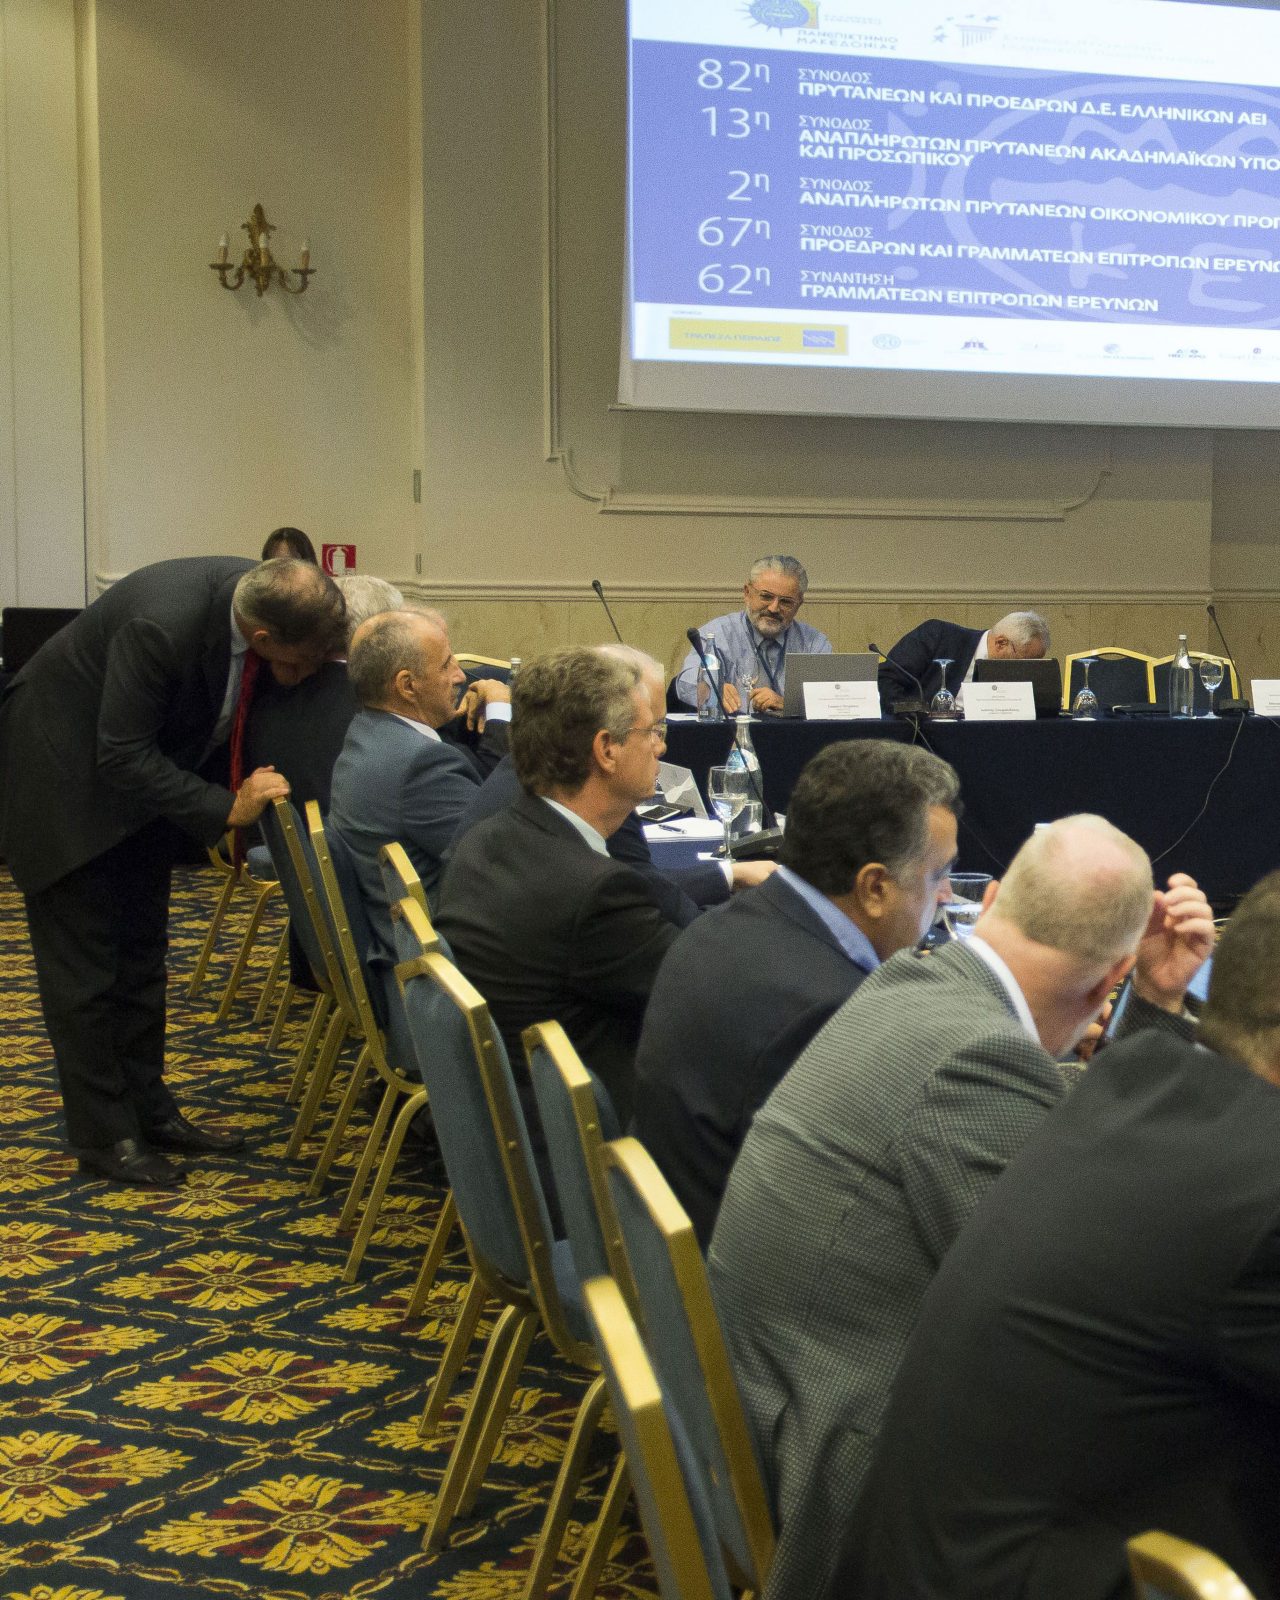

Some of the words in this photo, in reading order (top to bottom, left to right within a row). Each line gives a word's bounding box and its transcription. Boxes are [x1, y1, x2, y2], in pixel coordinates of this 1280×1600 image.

[698, 58, 771, 94] 82η
[798, 67, 873, 85] ΣΥΝΟΔΟΣ
[798, 81, 926, 104] ΠΡΥΤΑΝΕΩΝ
[930, 89, 963, 107] ΚΑΙ
[967, 93, 1077, 115] ΠΡΟΕΔΡΩΝ
[1081, 101, 1117, 117] Δ.Ε.
[1121, 104, 1234, 126] ΕΛΛΗΝΙΚΩΝ
[1237, 109, 1268, 126] ΑΕΙ
[701, 105, 771, 139] 13η
[798, 113, 873, 131] ΣΥΝΟΔΟΣ
[799, 129, 962, 152] ΑΝΑΠΛΗΡΩΤΩΝ
[964, 138, 1086, 160] ΠΡΥΤΑΝΕΩΝ
[799, 144, 838, 160] ΚΑΙ
[841, 146, 974, 167] ΠΡΟΣΩΠΙΚΟΥ
[727, 170, 770, 201] 2η
[799, 177, 874, 193] ΣΥΝΟΔΟΣ
[800, 191, 961, 212] ΑΝΑΠΛΗΡΩΤΩΝ
[965, 199, 1087, 219] ΠΡΥΤΑΝΕΩΝ
[1090, 206, 1230, 227] ΟΙΚΟΝΟΜΙΚΟΥ
[697, 216, 771, 247] 67η
[800, 224, 874, 239] ΣΥΝΟΔΟΣ
[800, 237, 915, 256] ΠΡΟΕΔΡΩΝ
[920, 243, 953, 258] ΚΑΙ
[957, 245, 1094, 264] ΓΡΑΜΜΑΤΕΩΝ
[1098, 252, 1209, 270] ΕΠΙΤΡΟΠΩΝ
[697, 263, 771, 295] 62η
[800, 270, 895, 286] ΣΥΝΑΝΤΗΣΗ
[801, 284, 943, 303] ΓΡΑΜΜΑΤΕΩΝ
[947, 290, 1063, 308] ΕΠΙΤΡΟΠΩΝ
[1067, 295, 1159, 312] ΕΡΕΥΝΩΝ
